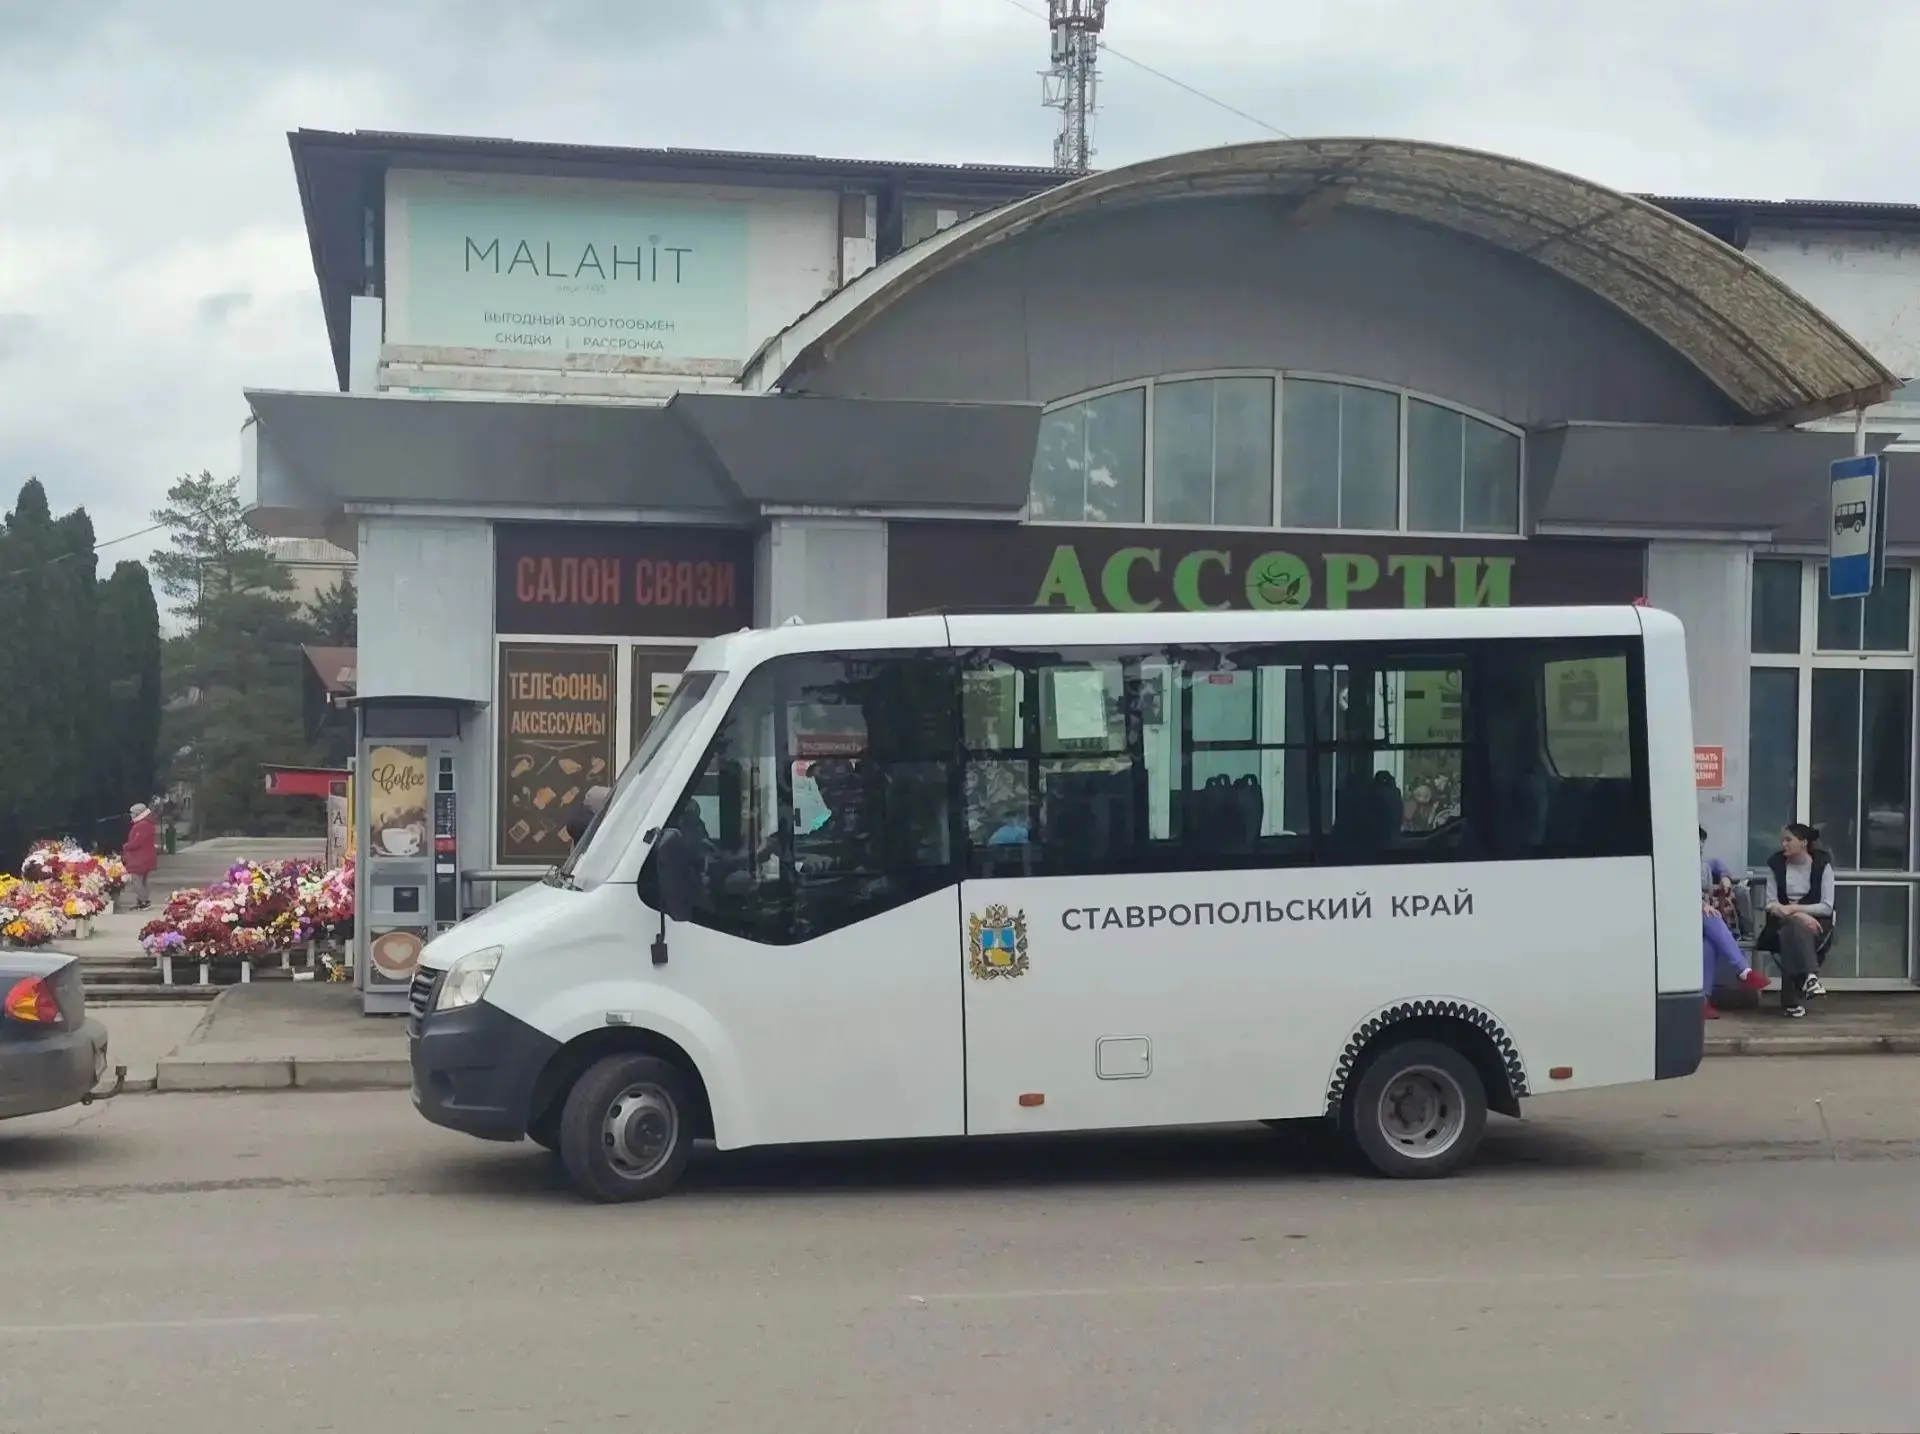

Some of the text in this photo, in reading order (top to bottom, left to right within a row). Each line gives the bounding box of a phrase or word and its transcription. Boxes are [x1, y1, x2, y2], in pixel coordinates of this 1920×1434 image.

[464, 235, 693, 283] MALAHIT
[484, 310, 676, 332] ВЫГОДНЫЙ ЗОЛОТООБМЕН
[494, 332, 665, 351] СКИДКИ РАССРОЧКА
[516, 555, 737, 608] САЛОН СВЯЗИ
[1035, 545, 1516, 611] АССОРТИ
[509, 672, 608, 702] ТЕЛЕФОНЫ
[510, 711, 606, 735] АКСЕССУАРЫ
[371, 764, 425, 795] Coffee
[1062, 888, 1474, 933] СТАВРОПОЛЬСКИЙ КРАЙ
